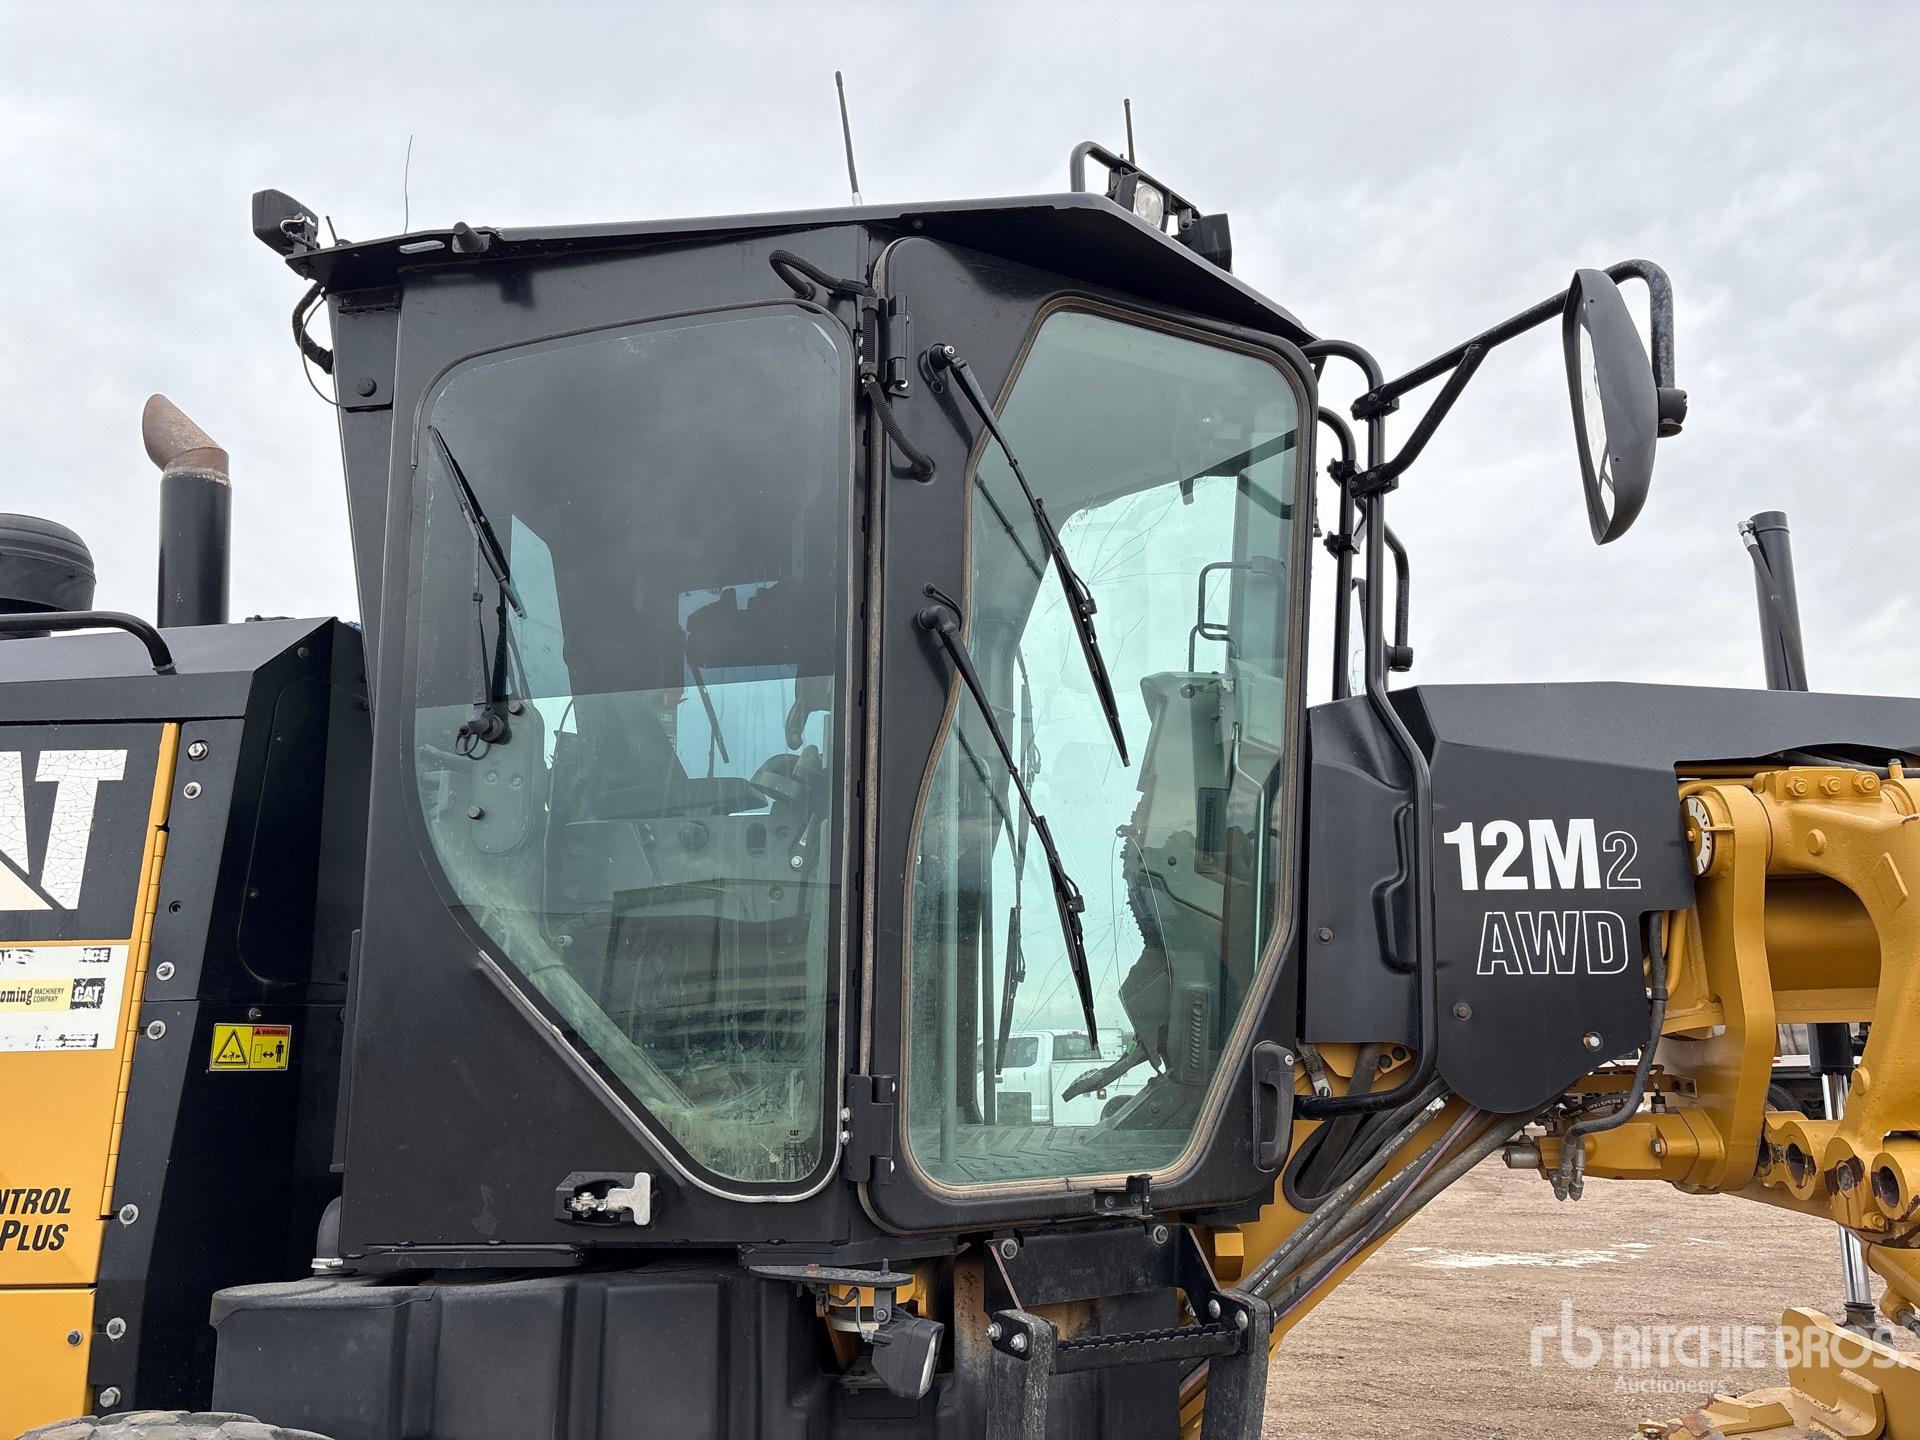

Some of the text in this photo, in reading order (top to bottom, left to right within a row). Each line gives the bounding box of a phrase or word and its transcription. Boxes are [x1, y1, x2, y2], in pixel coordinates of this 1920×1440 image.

[1476, 911, 1629, 975] AWD
[33, 995, 59, 1003] COMPANY
[34, 987, 65, 995] MACHINERY
[73, 986, 102, 1003] CAT
[0, 1220, 69, 1251] PLUS
